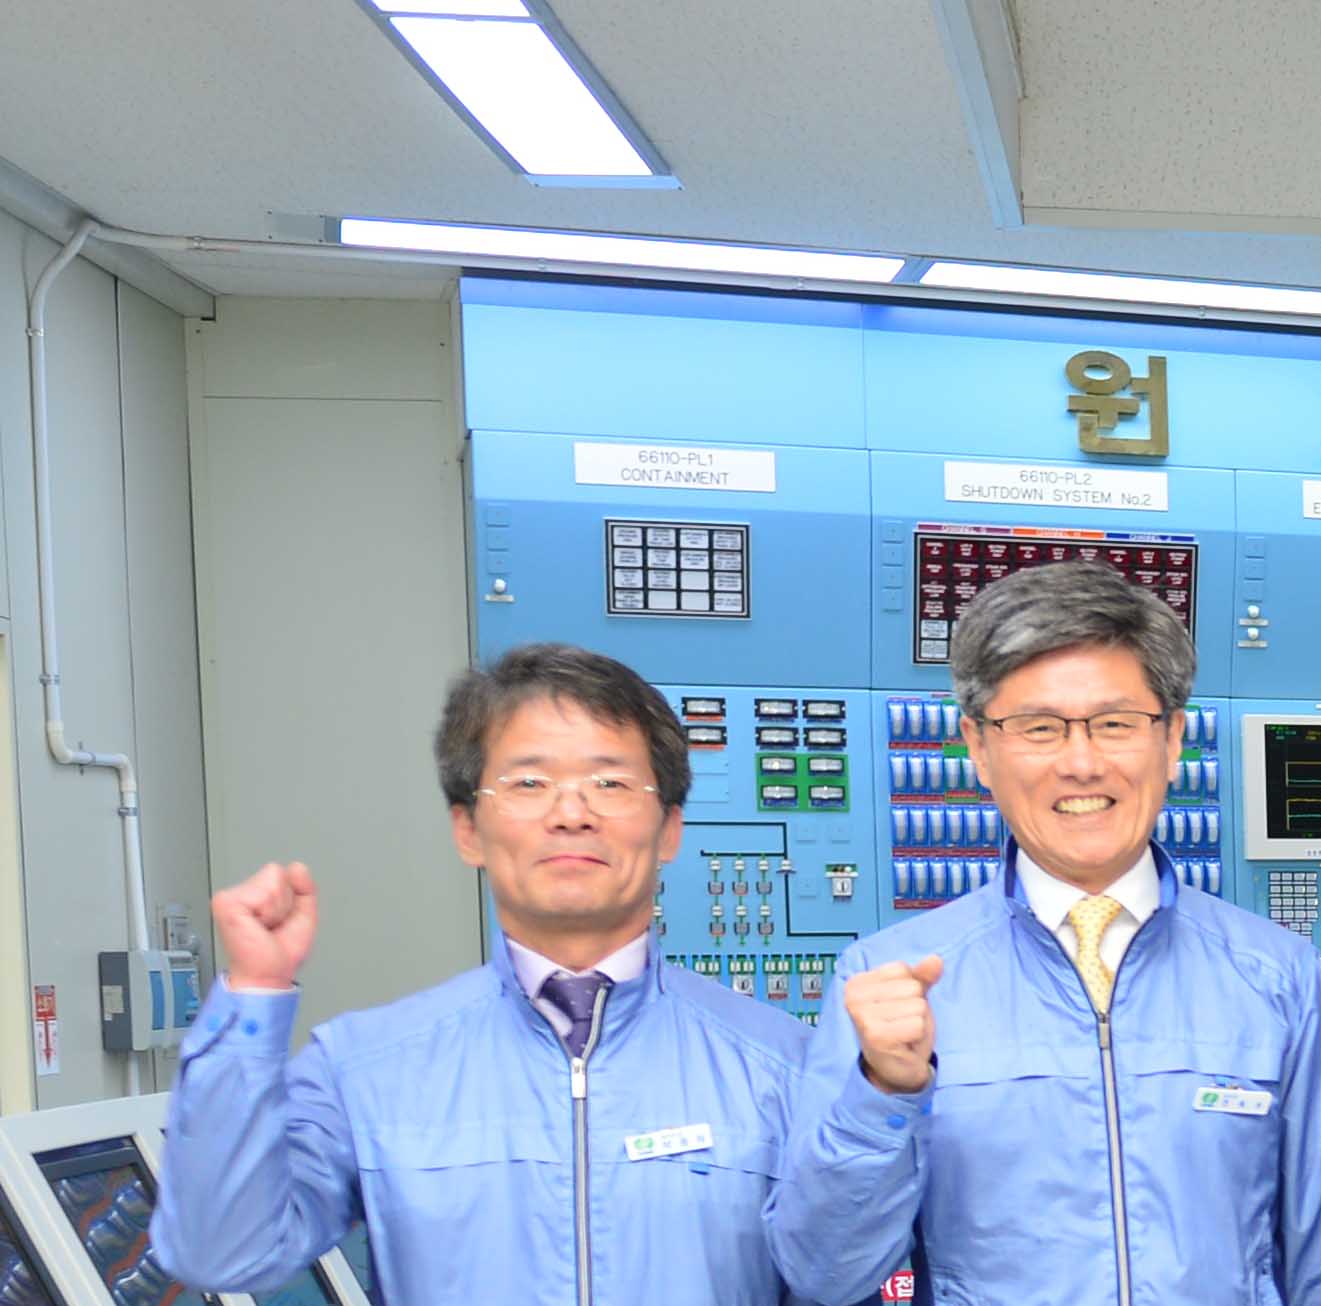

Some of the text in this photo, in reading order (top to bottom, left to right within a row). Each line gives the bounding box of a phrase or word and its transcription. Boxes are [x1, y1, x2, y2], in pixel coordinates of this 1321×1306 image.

[638, 450, 714, 466] 66110-PL1
[620, 467, 729, 485] CONTAINMENT
[1019, 470, 1093, 486] 66110-PL2
[961, 484, 1152, 506] SHUTDOWN SYSTEM No.2
